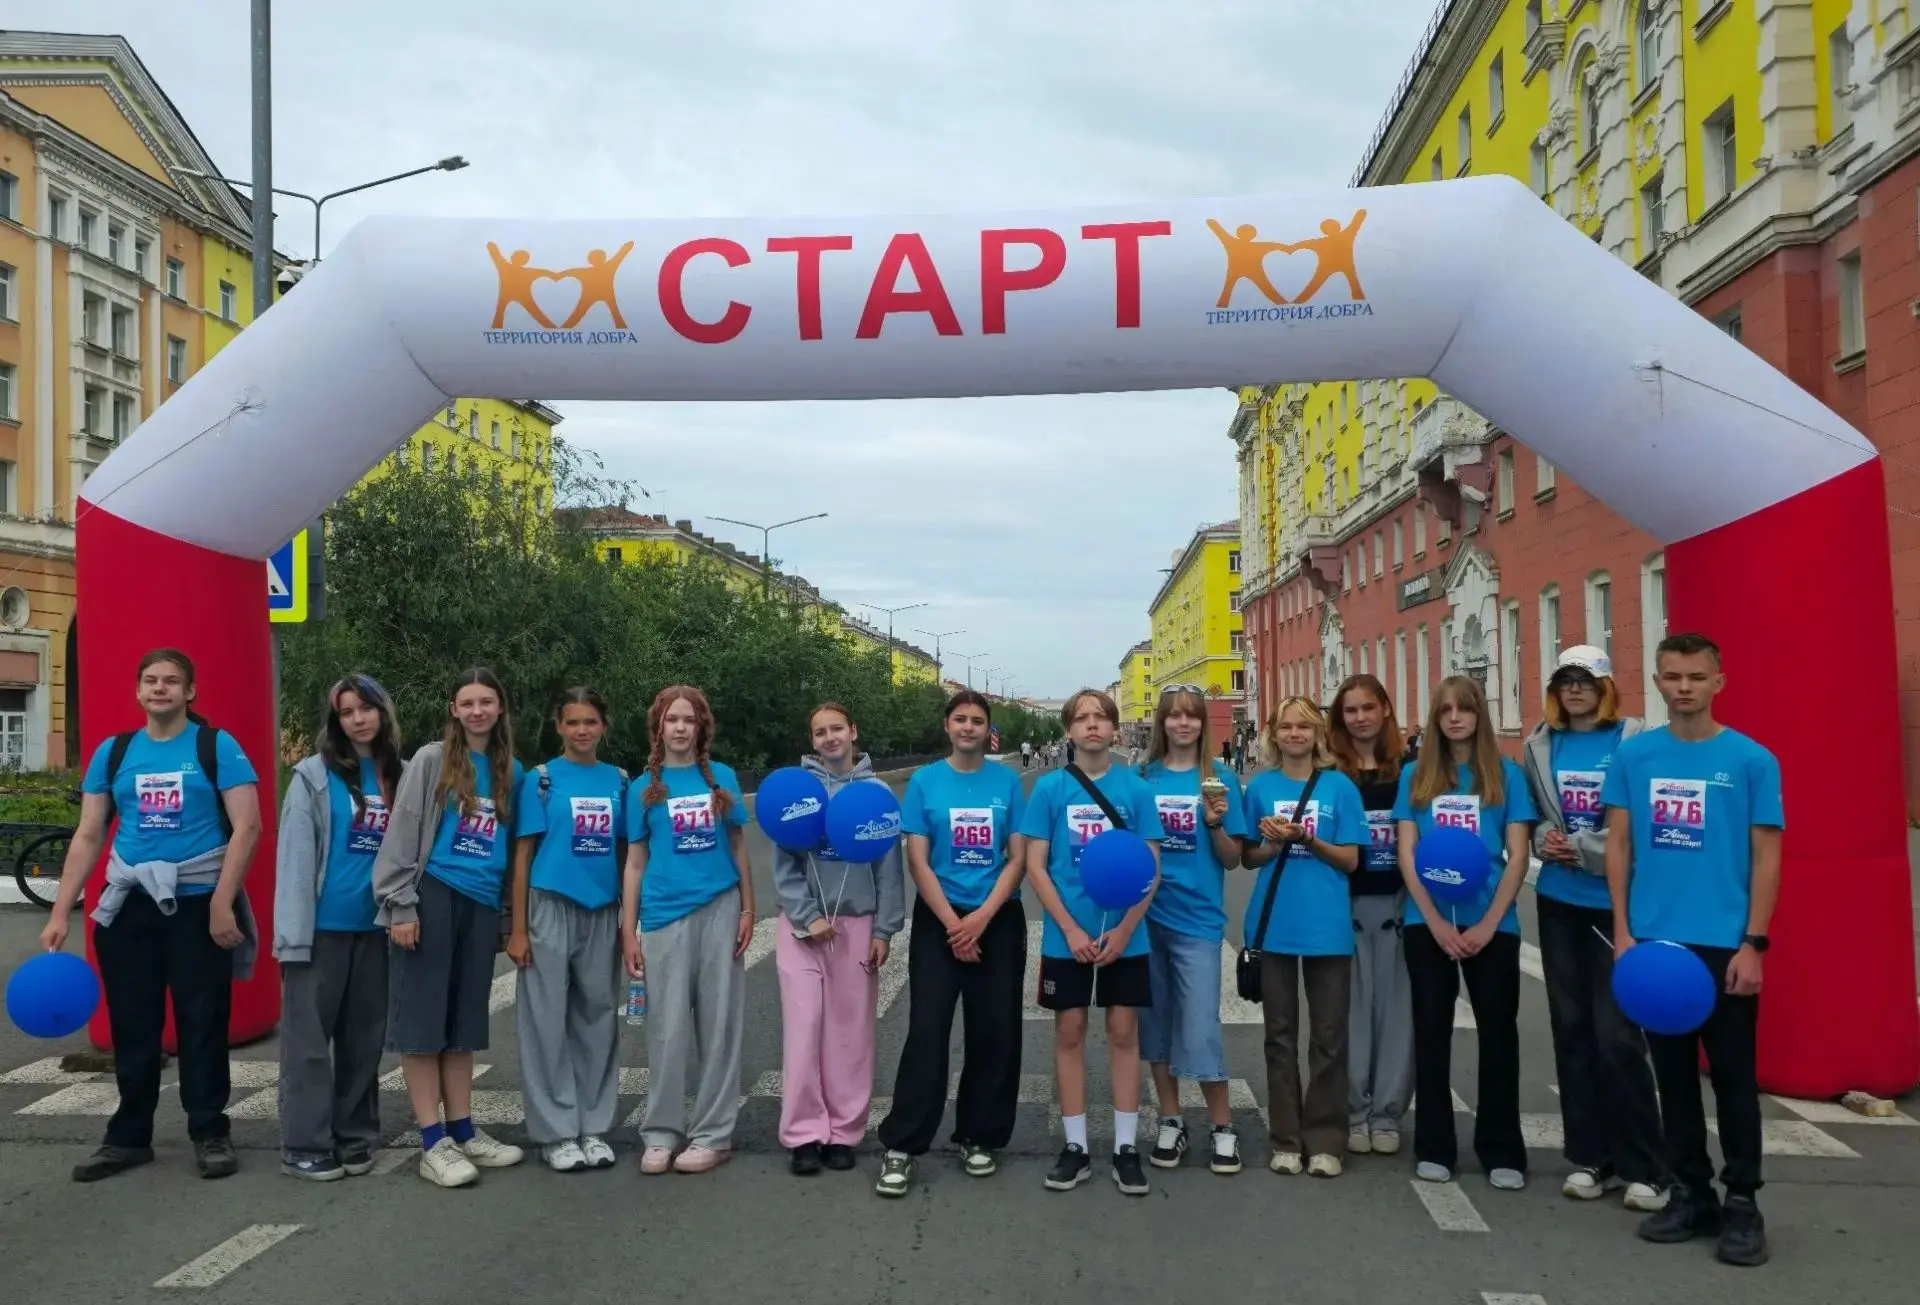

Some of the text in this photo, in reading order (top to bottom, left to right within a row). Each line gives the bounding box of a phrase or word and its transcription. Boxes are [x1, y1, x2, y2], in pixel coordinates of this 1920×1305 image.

[658, 220, 1172, 344] СТАРТ
[1206, 303, 1374, 324] ТЕРРИТОРИЯ ДОБРА
[483, 331, 641, 345] ТЕРРИТОРИЯ ДОБРА
[1562, 790, 1600, 812] 262
[1654, 799, 1702, 825] 276
[457, 814, 497, 838] 274
[575, 813, 610, 835] 272
[673, 809, 711, 833] 271
[953, 825, 991, 846] 269
